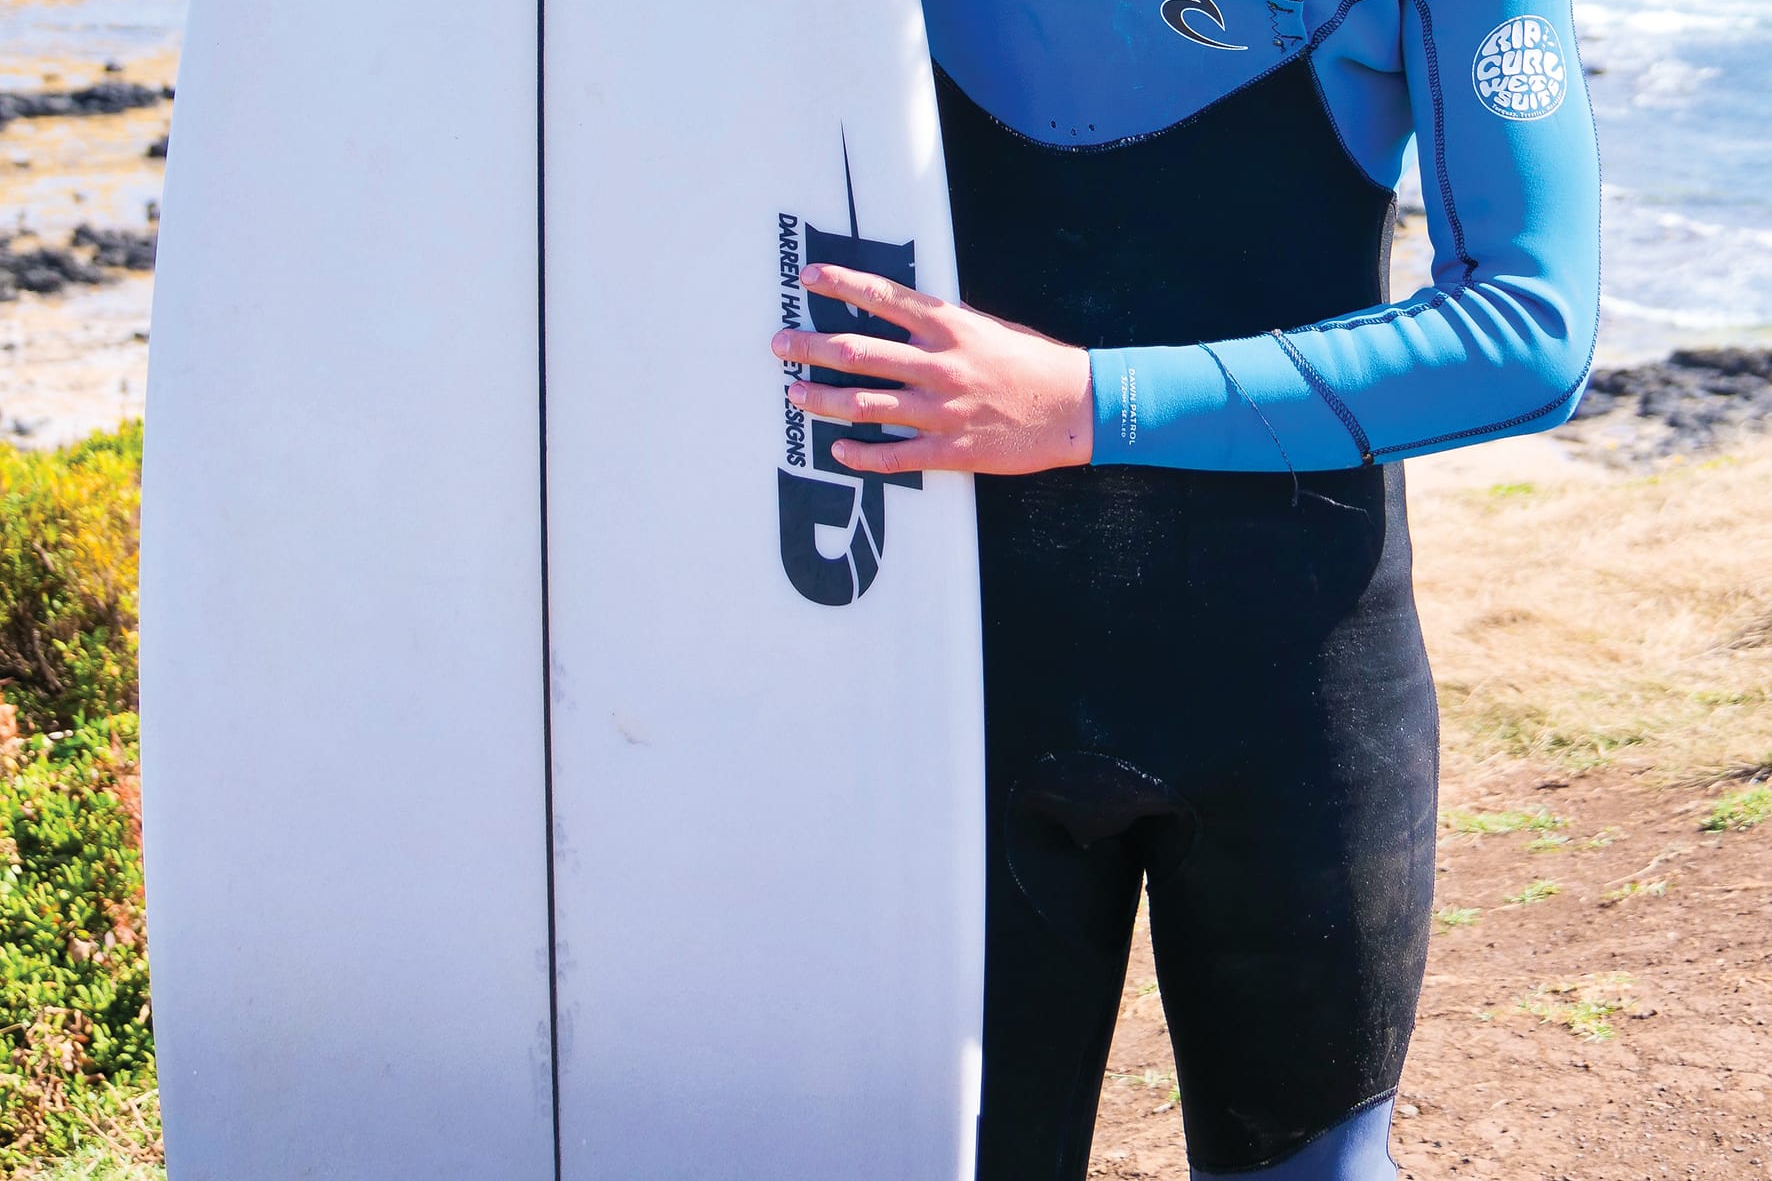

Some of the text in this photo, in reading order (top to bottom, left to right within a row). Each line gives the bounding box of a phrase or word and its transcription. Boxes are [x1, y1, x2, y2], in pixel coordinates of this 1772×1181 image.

[1476, 48, 1564, 82] CURL
[1481, 19, 1541, 56] RIP
[778, 212, 807, 468] DARREN HANEY ESIGNS
[1128, 367, 1137, 446] DAWN PATROL
